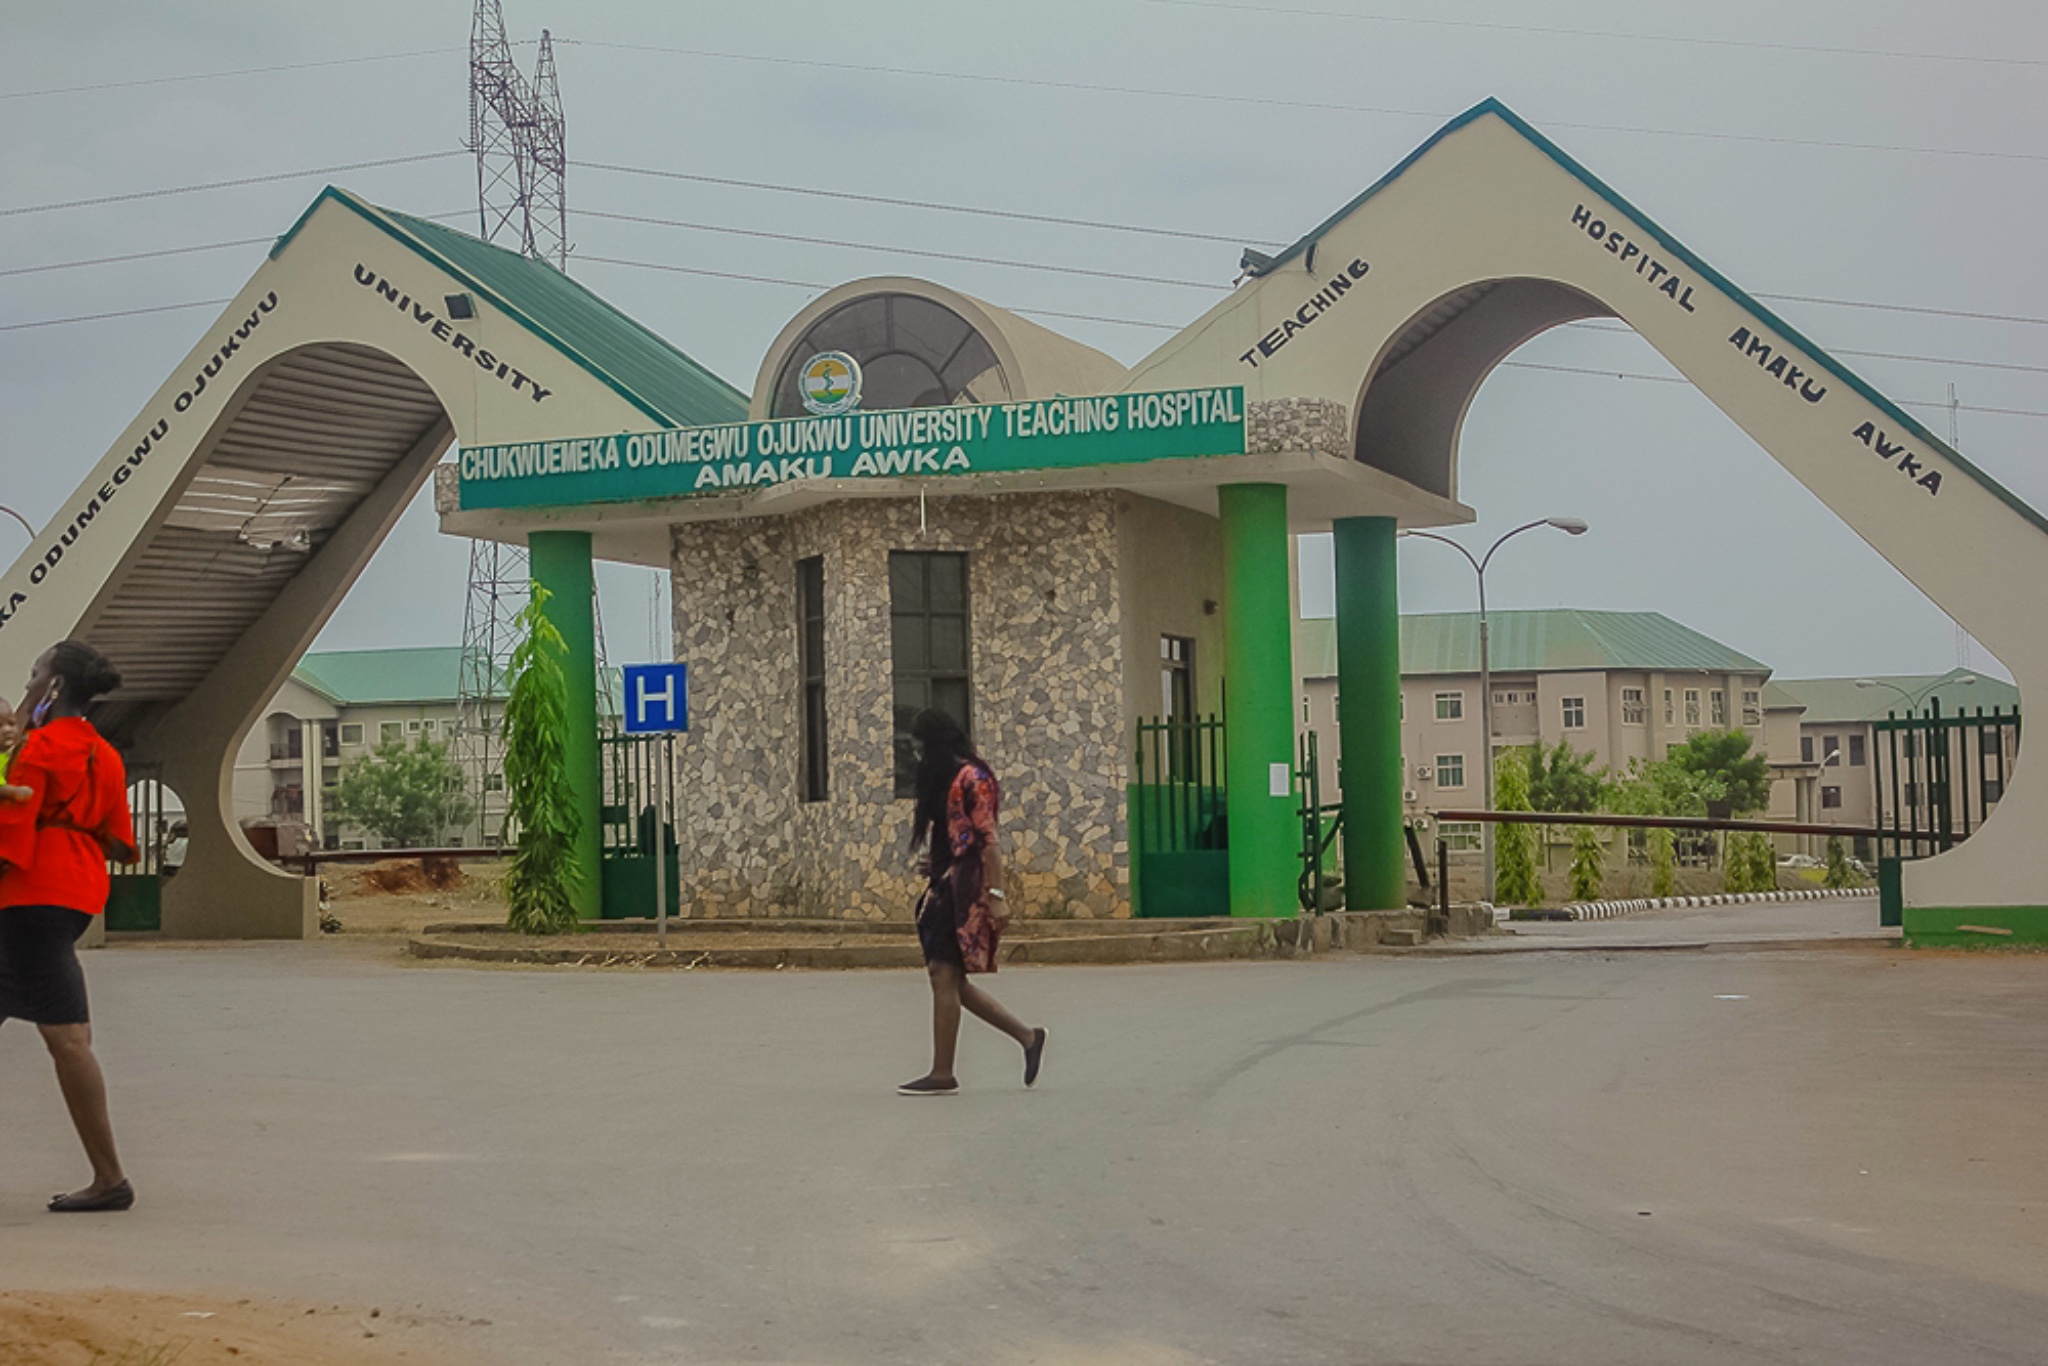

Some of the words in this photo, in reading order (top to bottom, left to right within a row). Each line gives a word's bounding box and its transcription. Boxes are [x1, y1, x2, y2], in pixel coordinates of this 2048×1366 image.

[354, 263, 552, 403] UNIVERSITY
[1239, 259, 1369, 367] TEACHING
[1571, 204, 1696, 312] HOSPITAL
[1728, 327, 1827, 403] AMAKU
[1852, 421, 1942, 496] AWKA
[30, 418, 169, 585] ODUMEGWU
[174, 291, 278, 413] OJUKWU
[462, 438, 620, 481] CHUKWUEMEKA
[626, 426, 748, 468] ODUMEGWU
[757, 418, 852, 456] OJUKWU
[859, 406, 992, 449] UNIVERSITY
[1001, 396, 1119, 438] TEACHING
[1127, 388, 1241, 430] HOSPITAL
[694, 456, 833, 489] AMAKU
[851, 446, 970, 476] AWKA
[637, 674, 675, 723] H
